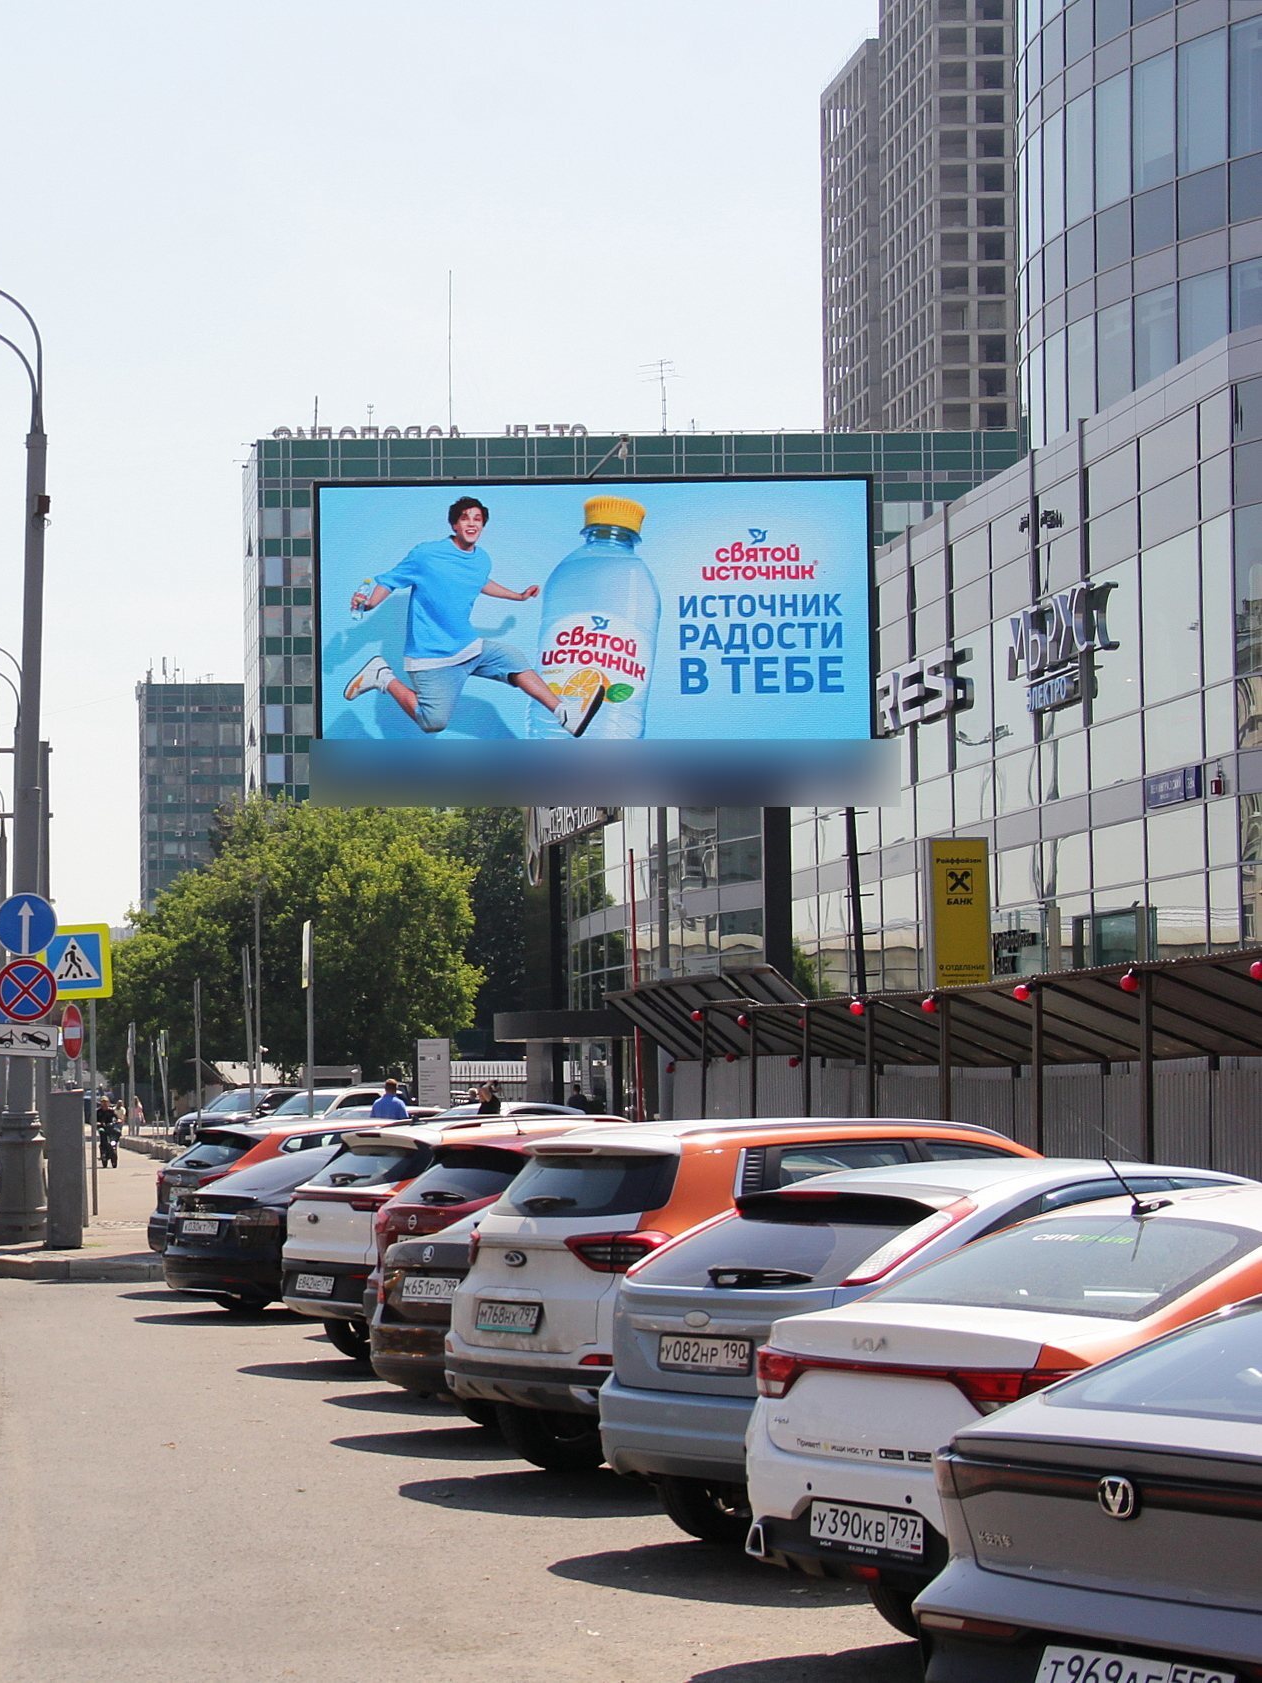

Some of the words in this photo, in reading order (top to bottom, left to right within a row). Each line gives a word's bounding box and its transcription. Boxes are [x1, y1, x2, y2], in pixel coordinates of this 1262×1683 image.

[679, 593, 843, 618] ИСТОЧНИК
[679, 622, 843, 654] РАДОСТИ
[680, 657, 709, 695] В
[721, 656, 845, 694] ТЕБЕ
[946, 898, 973, 906] БАНК
[796, 1438, 821, 1449] Привет!
